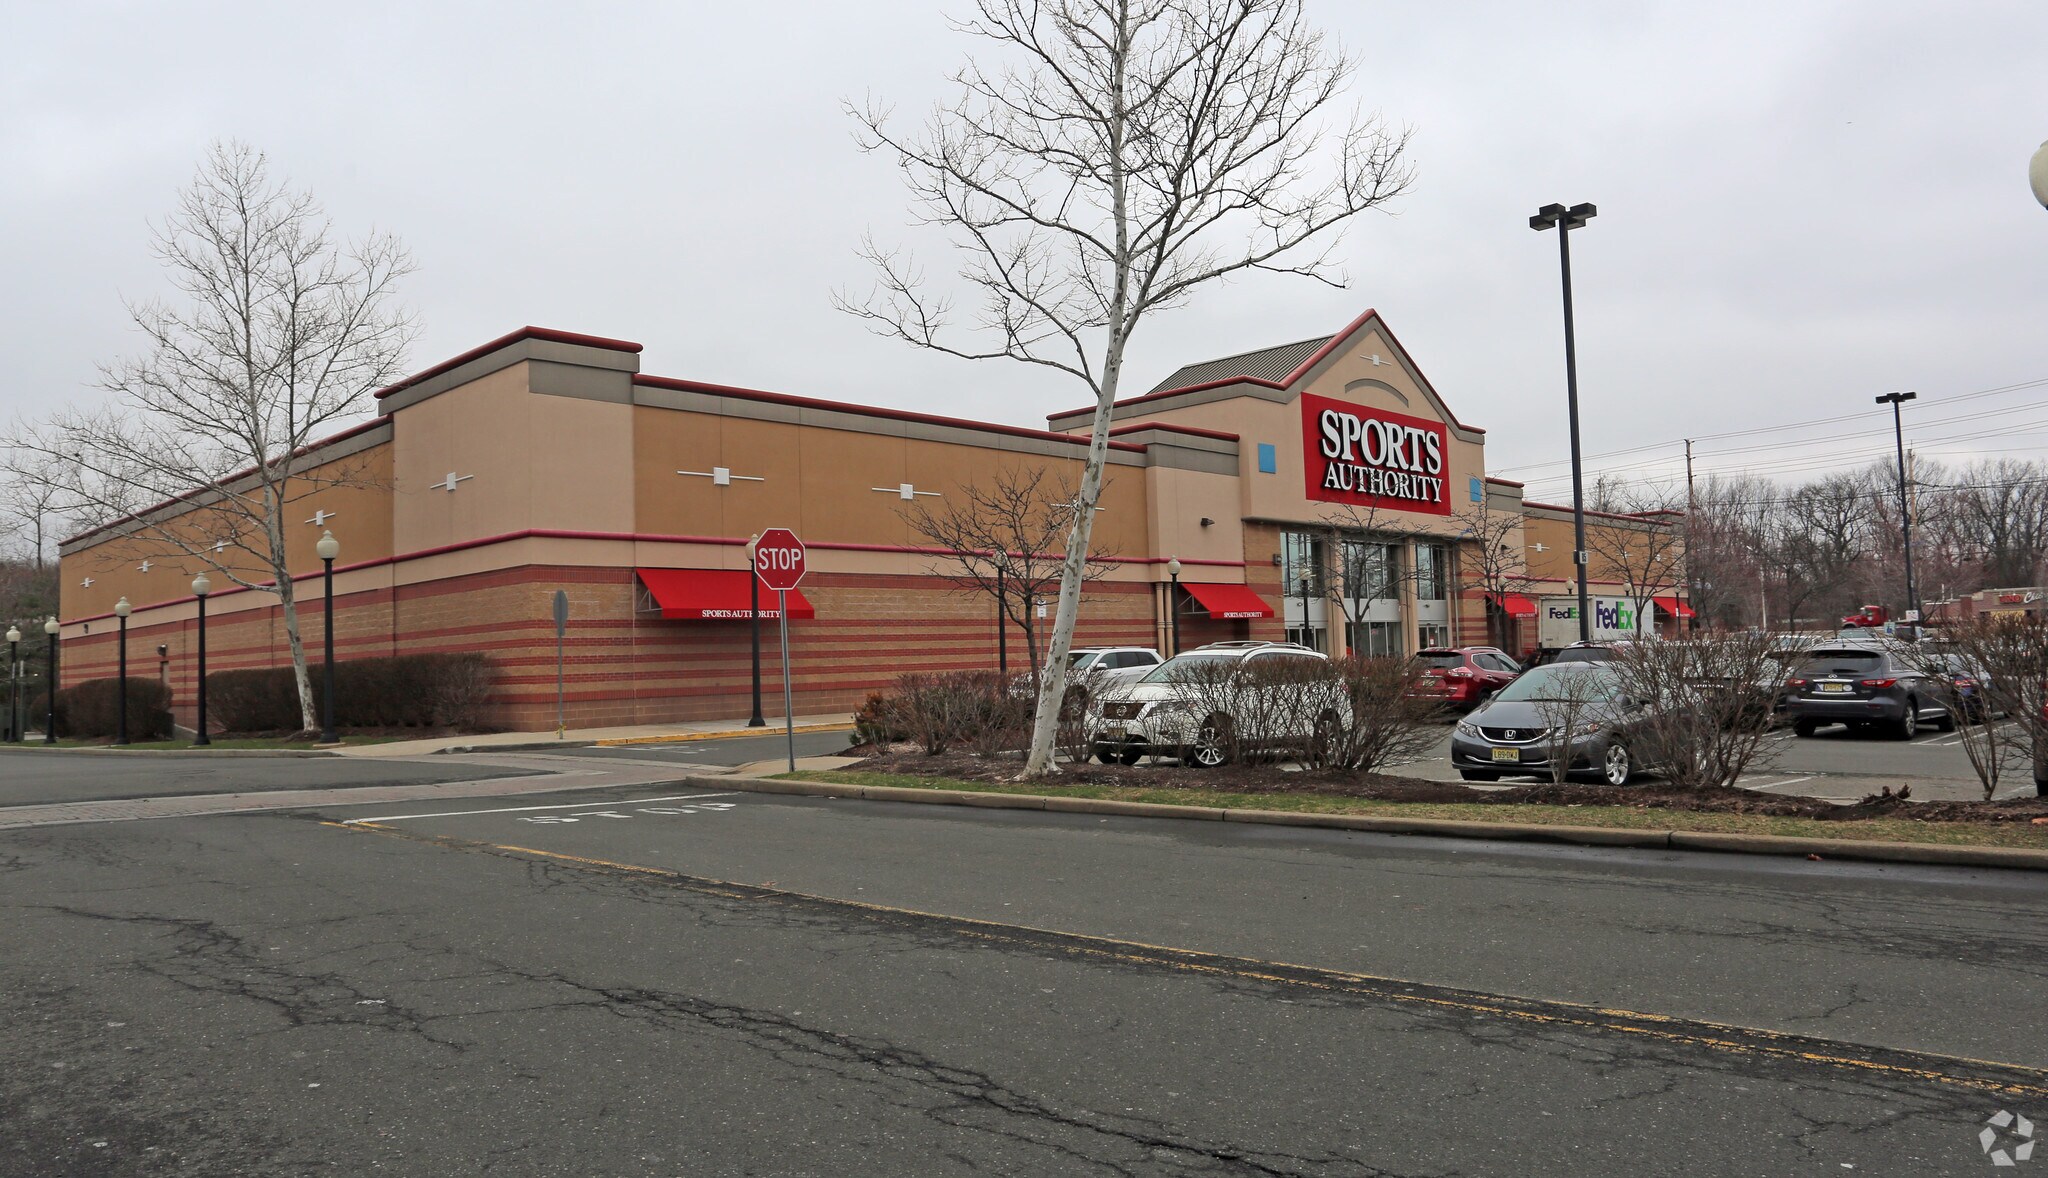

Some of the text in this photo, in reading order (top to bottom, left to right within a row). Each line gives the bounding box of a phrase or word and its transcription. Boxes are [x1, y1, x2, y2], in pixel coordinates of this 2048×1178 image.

[1321, 409, 1442, 475] SPORTS
[1324, 461, 1443, 503] AUTHORITY
[758, 547, 802, 570] STOP
[702, 609, 731, 618] SPORTS
[1549, 607, 1580, 619] FedE
[1596, 600, 1634, 630] FedEx
[516, 803, 736, 824] STOP
